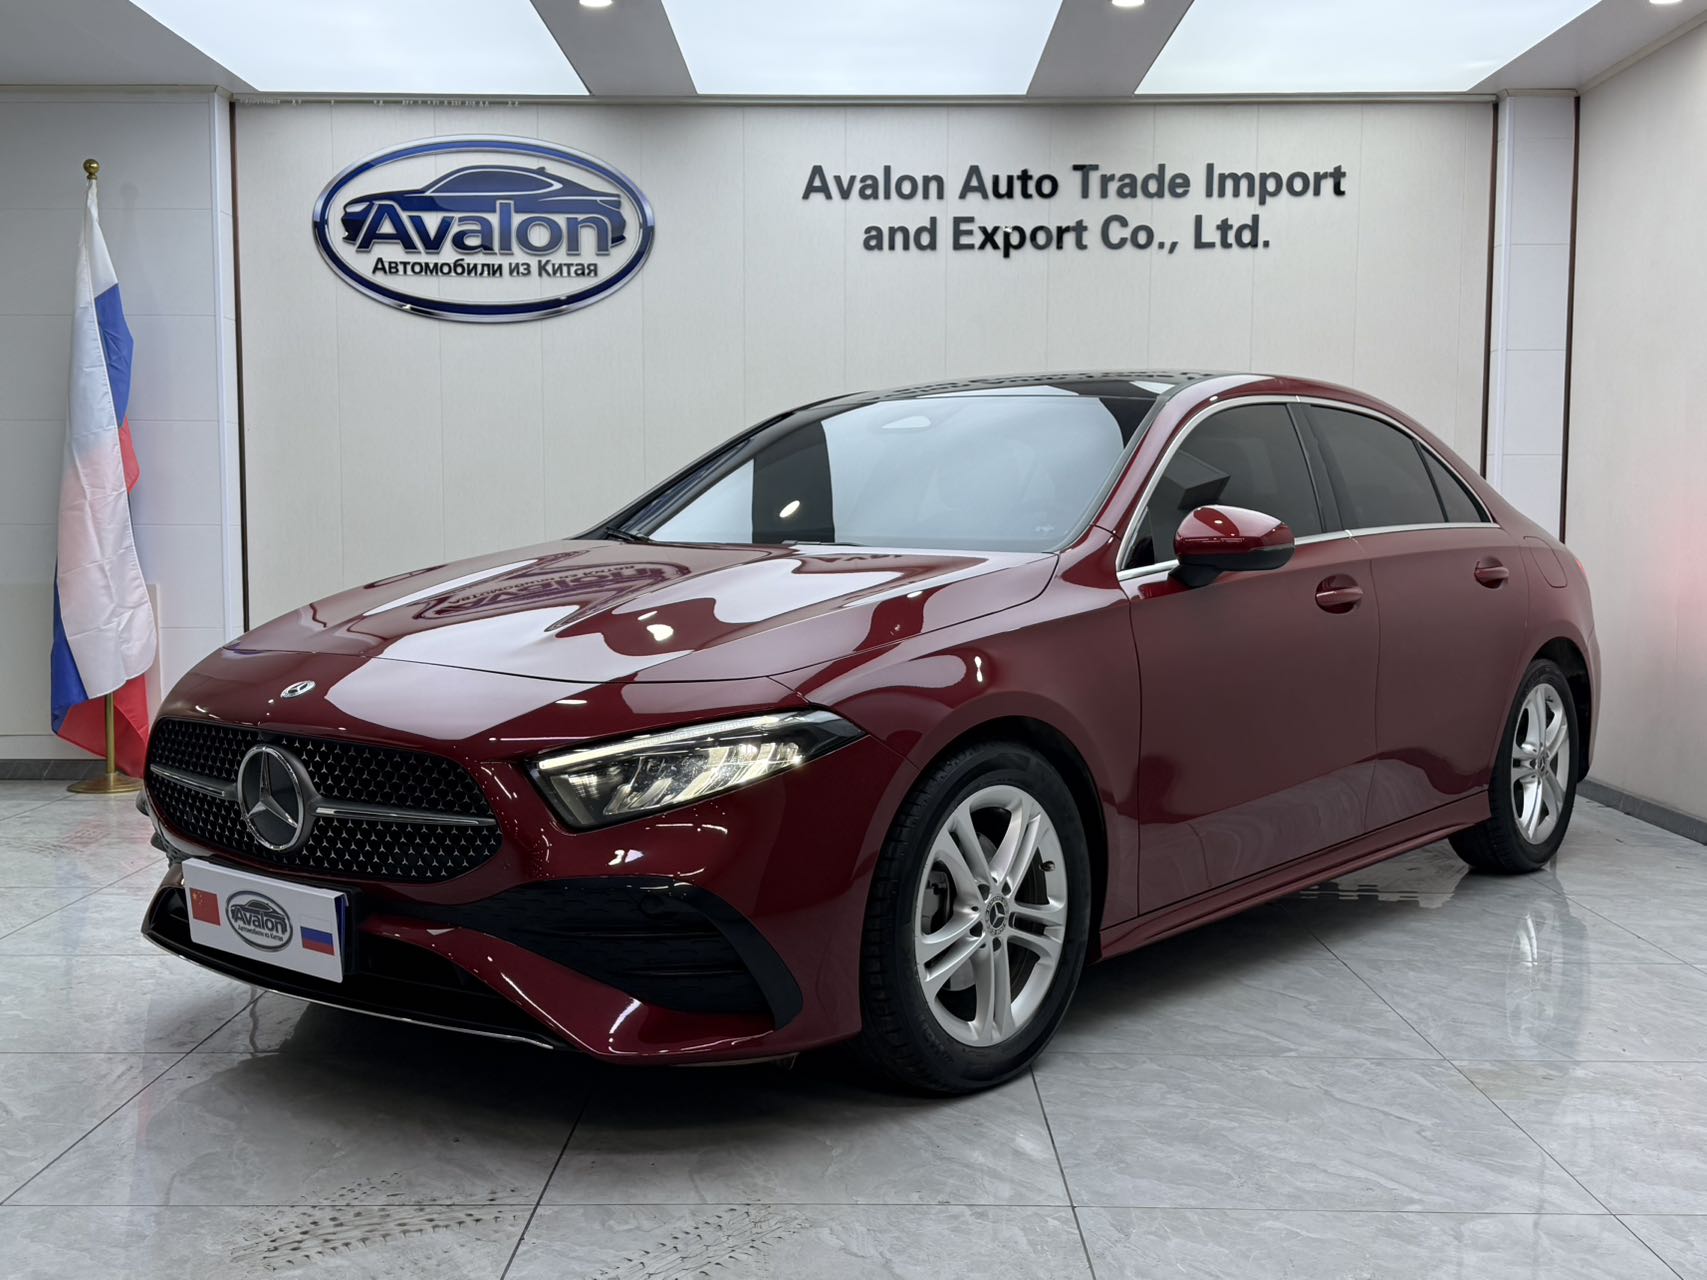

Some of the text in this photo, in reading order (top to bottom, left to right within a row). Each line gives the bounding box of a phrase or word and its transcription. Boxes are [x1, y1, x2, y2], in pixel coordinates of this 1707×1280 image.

[802, 163, 1346, 205] Avalon Auto Trade Import
[356, 200, 611, 253] Avalon
[862, 214, 1271, 257] and Export Co., Ltd.
[372, 257, 599, 277] Автомобили из Китая
[234, 908, 287, 935] Avalon
